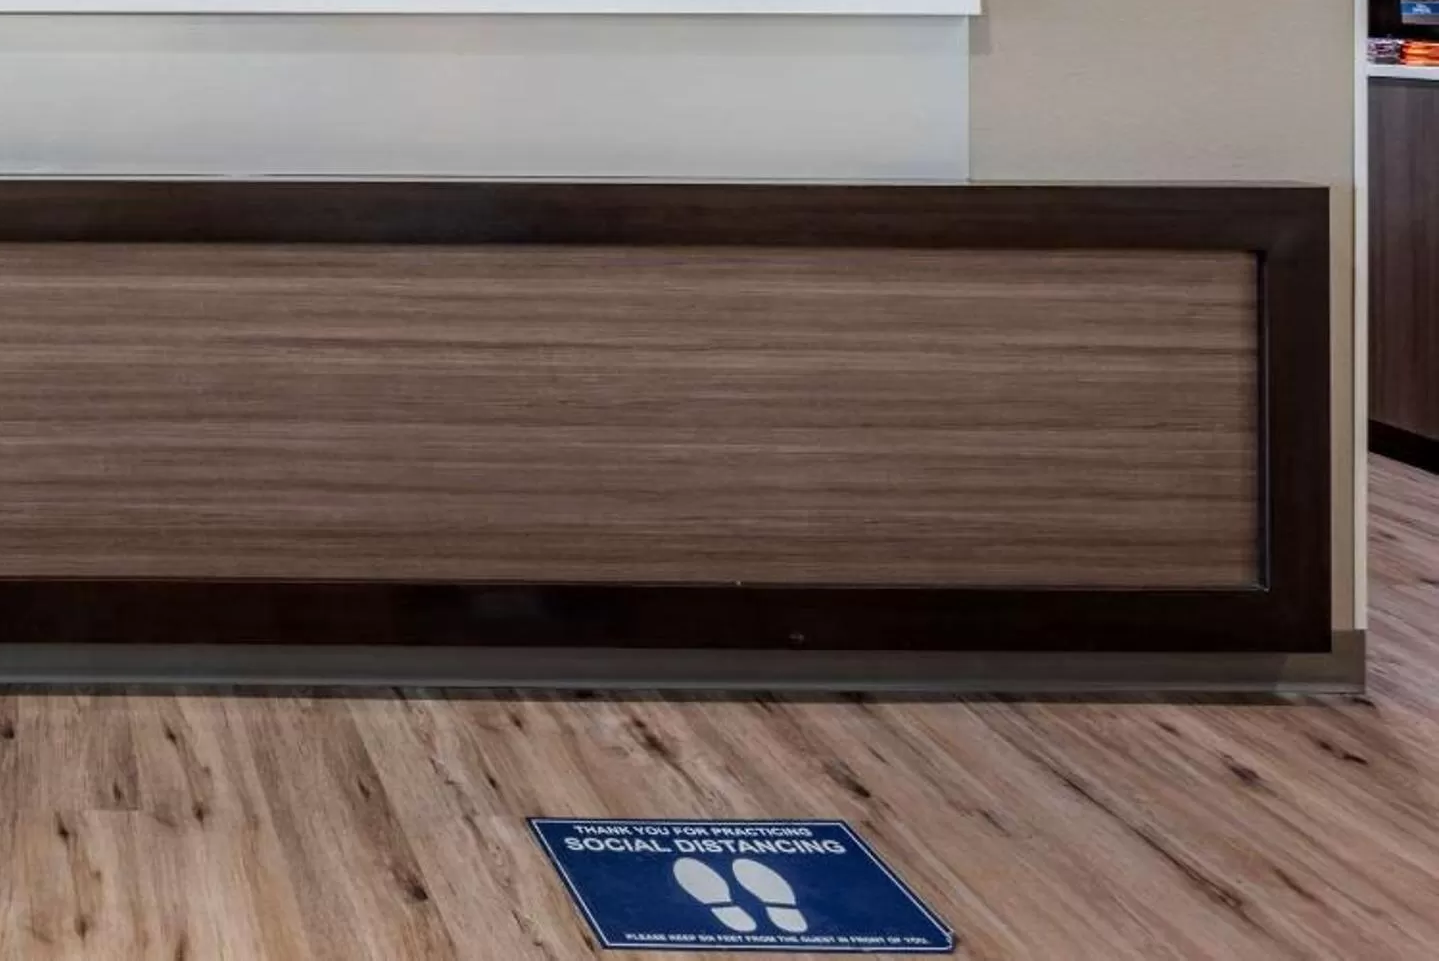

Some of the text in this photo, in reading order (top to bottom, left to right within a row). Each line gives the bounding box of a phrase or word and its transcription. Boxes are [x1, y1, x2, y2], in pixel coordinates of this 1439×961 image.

[573, 825, 812, 837] THANK YOU FOR PRACTICING
[565, 837, 847, 854] SOCIAL DISTANCING
